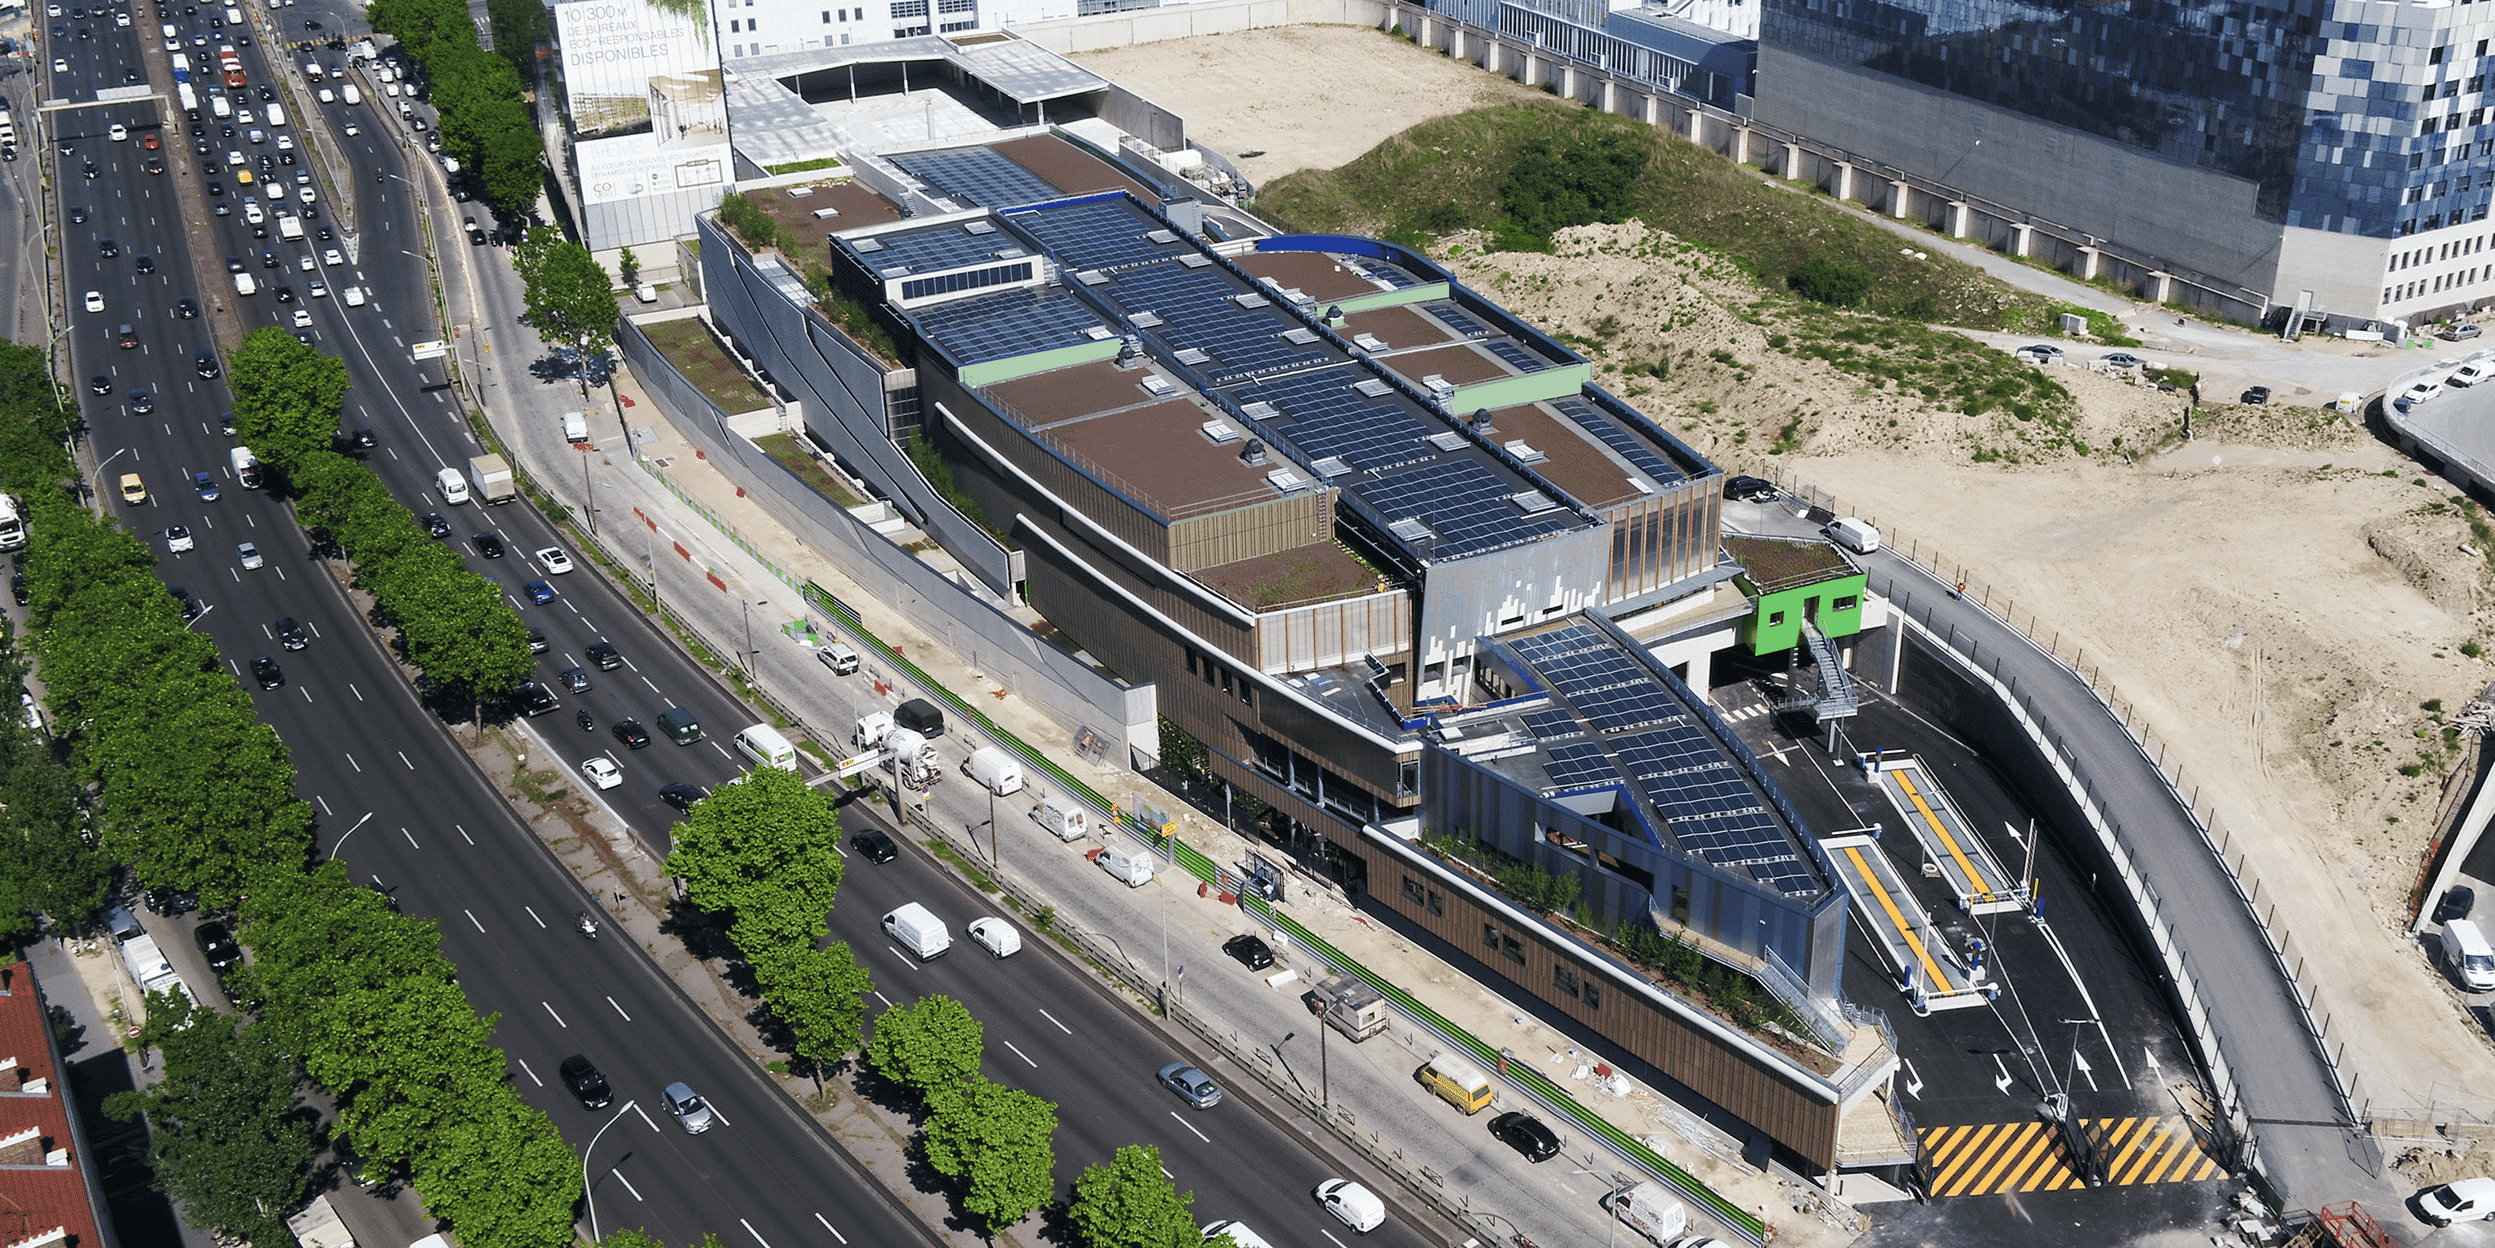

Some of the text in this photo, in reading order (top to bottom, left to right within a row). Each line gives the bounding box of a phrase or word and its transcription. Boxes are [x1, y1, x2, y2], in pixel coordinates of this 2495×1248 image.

[564, 9, 581, 22] 10
[586, 5, 616, 20] 300
[567, 20, 637, 36] DE BUREAUX
[569, 27, 684, 49] ECO-RESPONSABLES
[571, 43, 669, 66] DISPONIBLES
